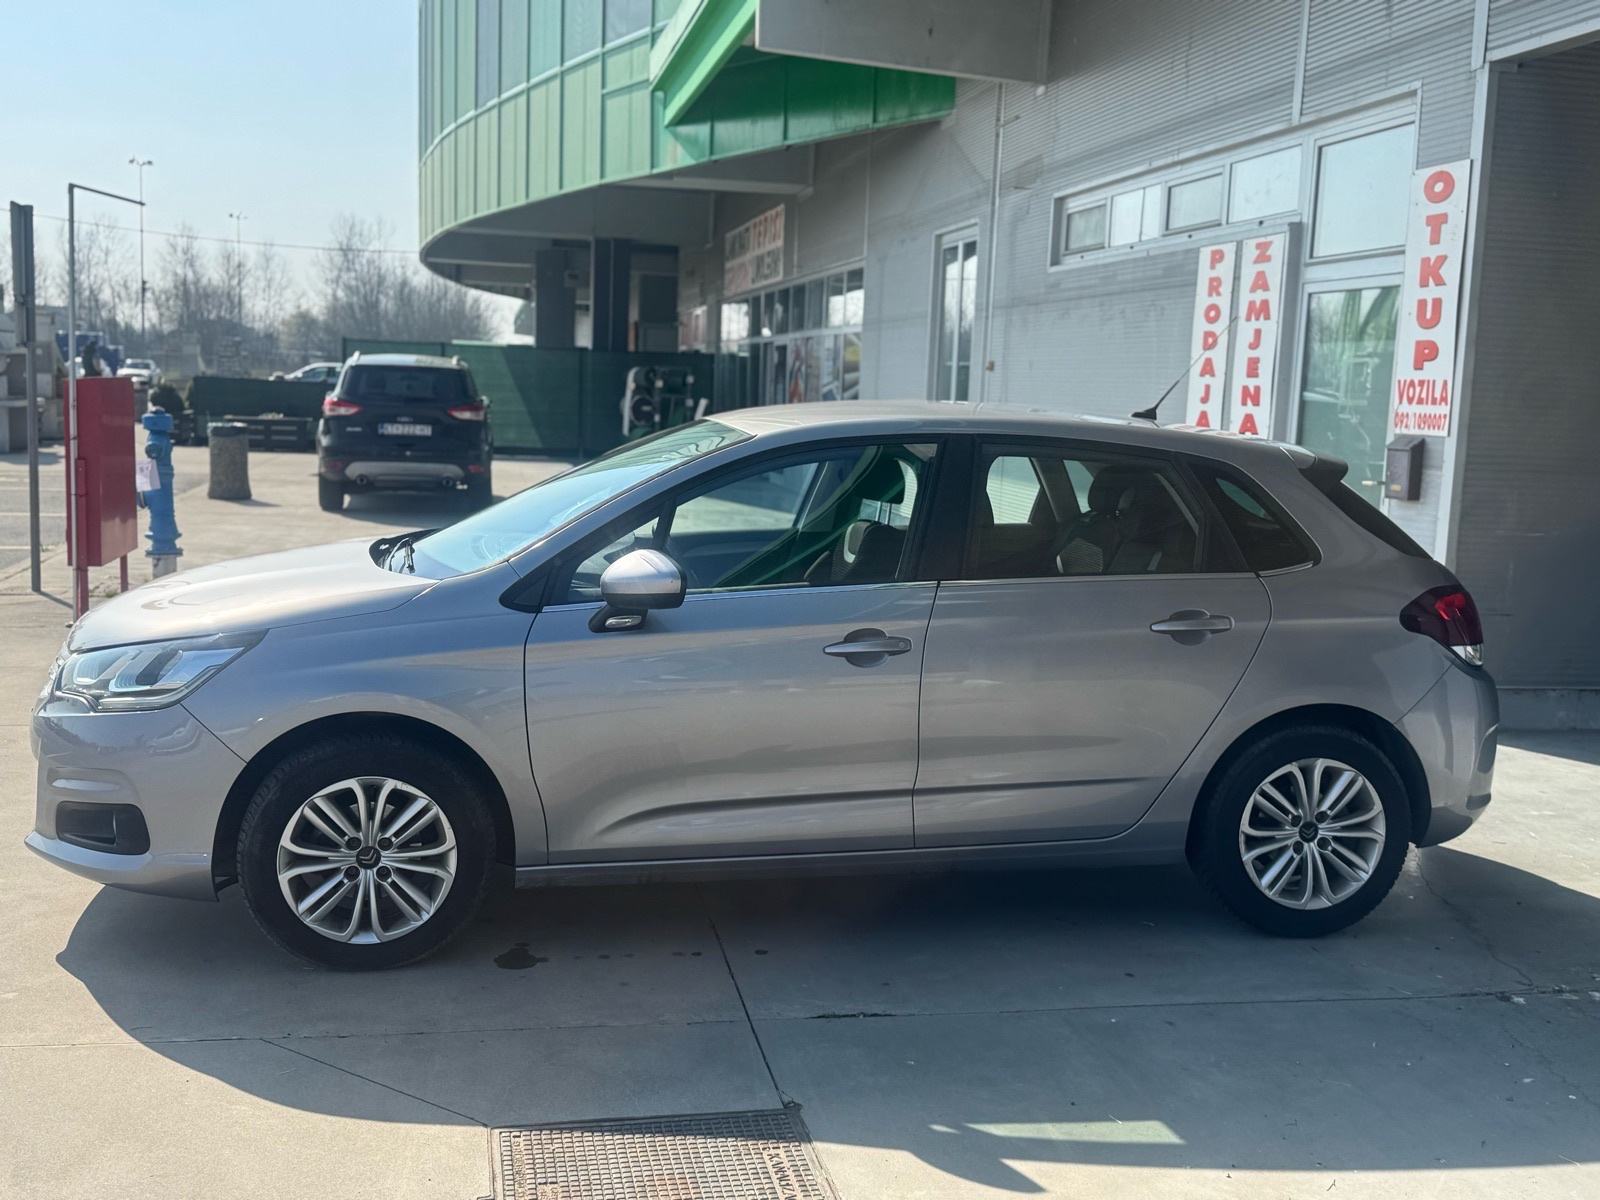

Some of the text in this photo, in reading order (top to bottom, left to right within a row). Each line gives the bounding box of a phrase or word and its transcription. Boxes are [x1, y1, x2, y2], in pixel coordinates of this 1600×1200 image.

[1195, 248, 1226, 429] PRODAJA
[1238, 240, 1274, 436] ZAMJENA
[1413, 170, 1455, 371] OTKUP
[1397, 378, 1449, 407] VOZILA
[766, 1153, 798, 1200] KANALIZA
